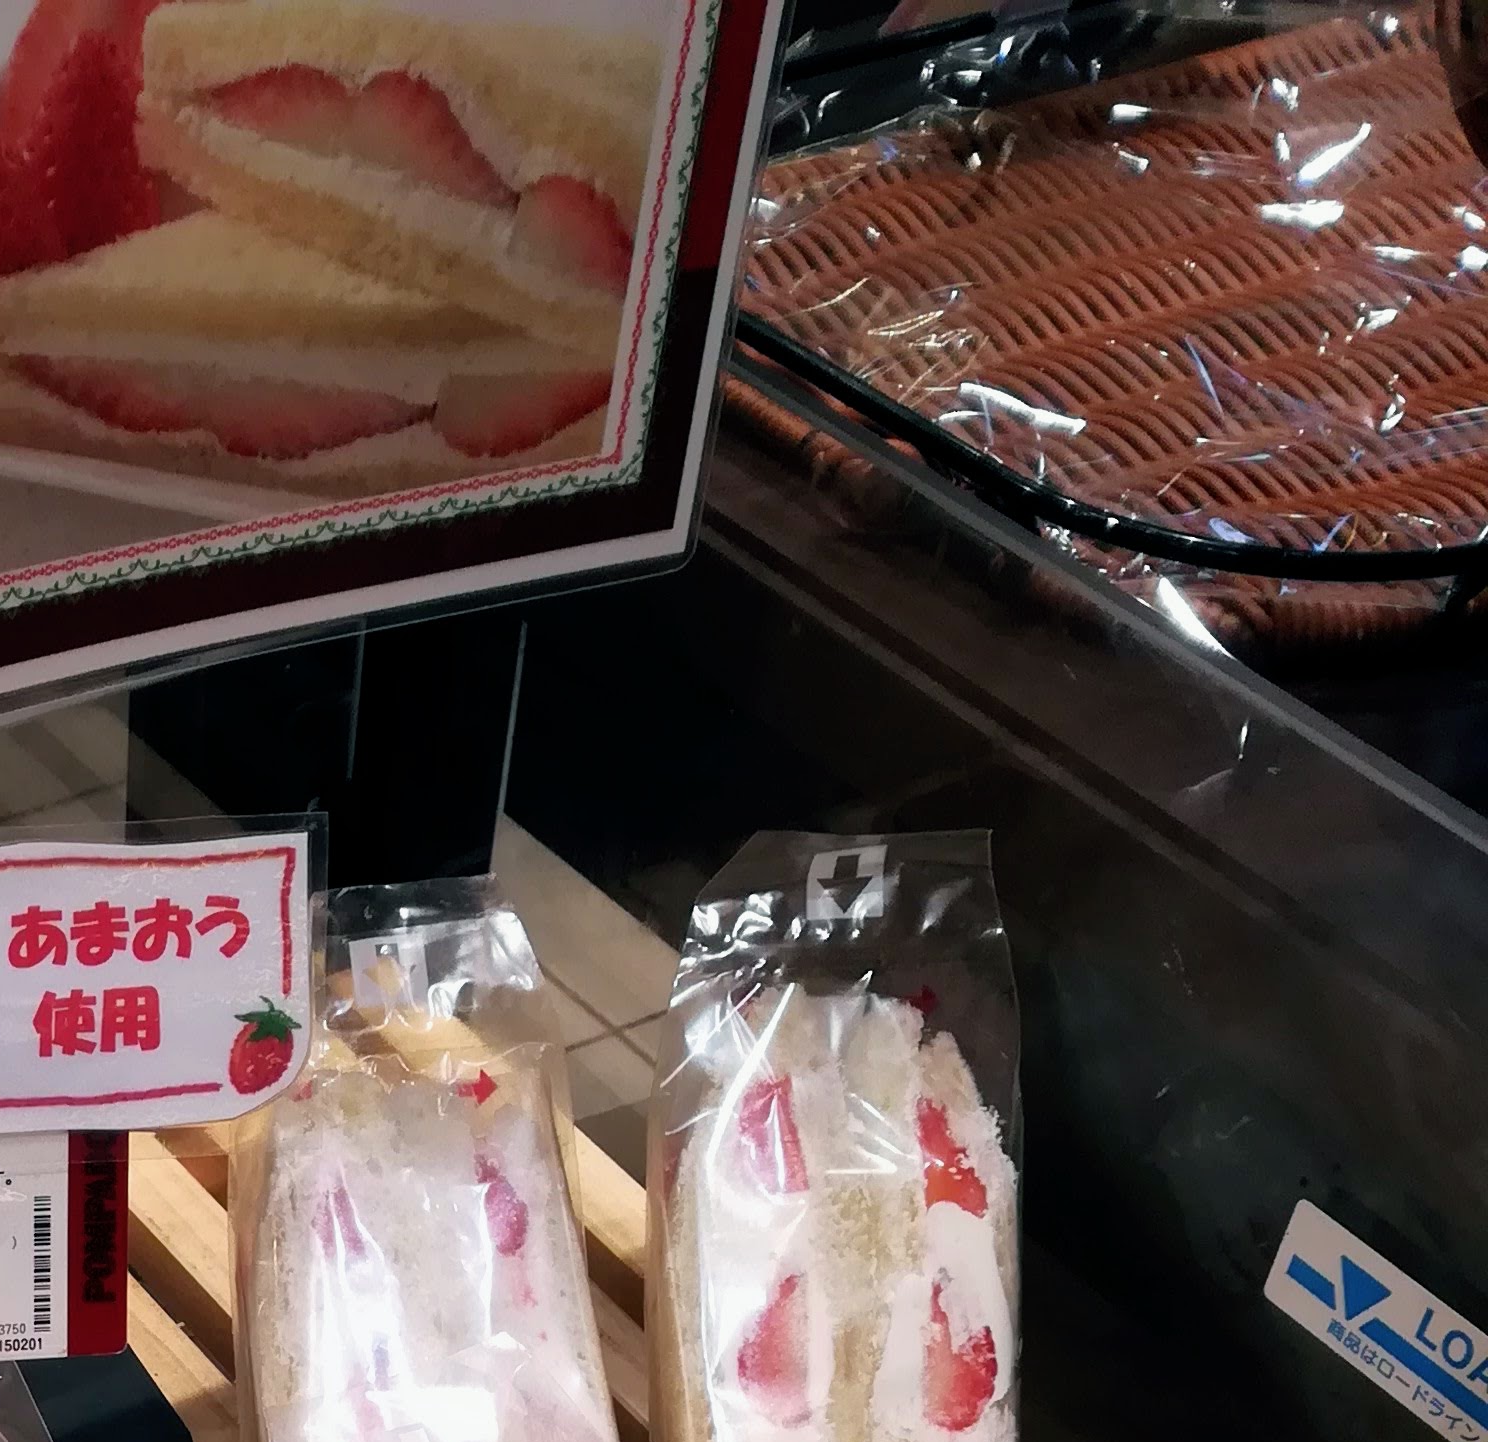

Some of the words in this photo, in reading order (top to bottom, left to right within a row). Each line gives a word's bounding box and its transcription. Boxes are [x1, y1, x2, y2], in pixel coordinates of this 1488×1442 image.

[7, 894, 250, 969] あまおう
[32, 985, 161, 1058] 使用
